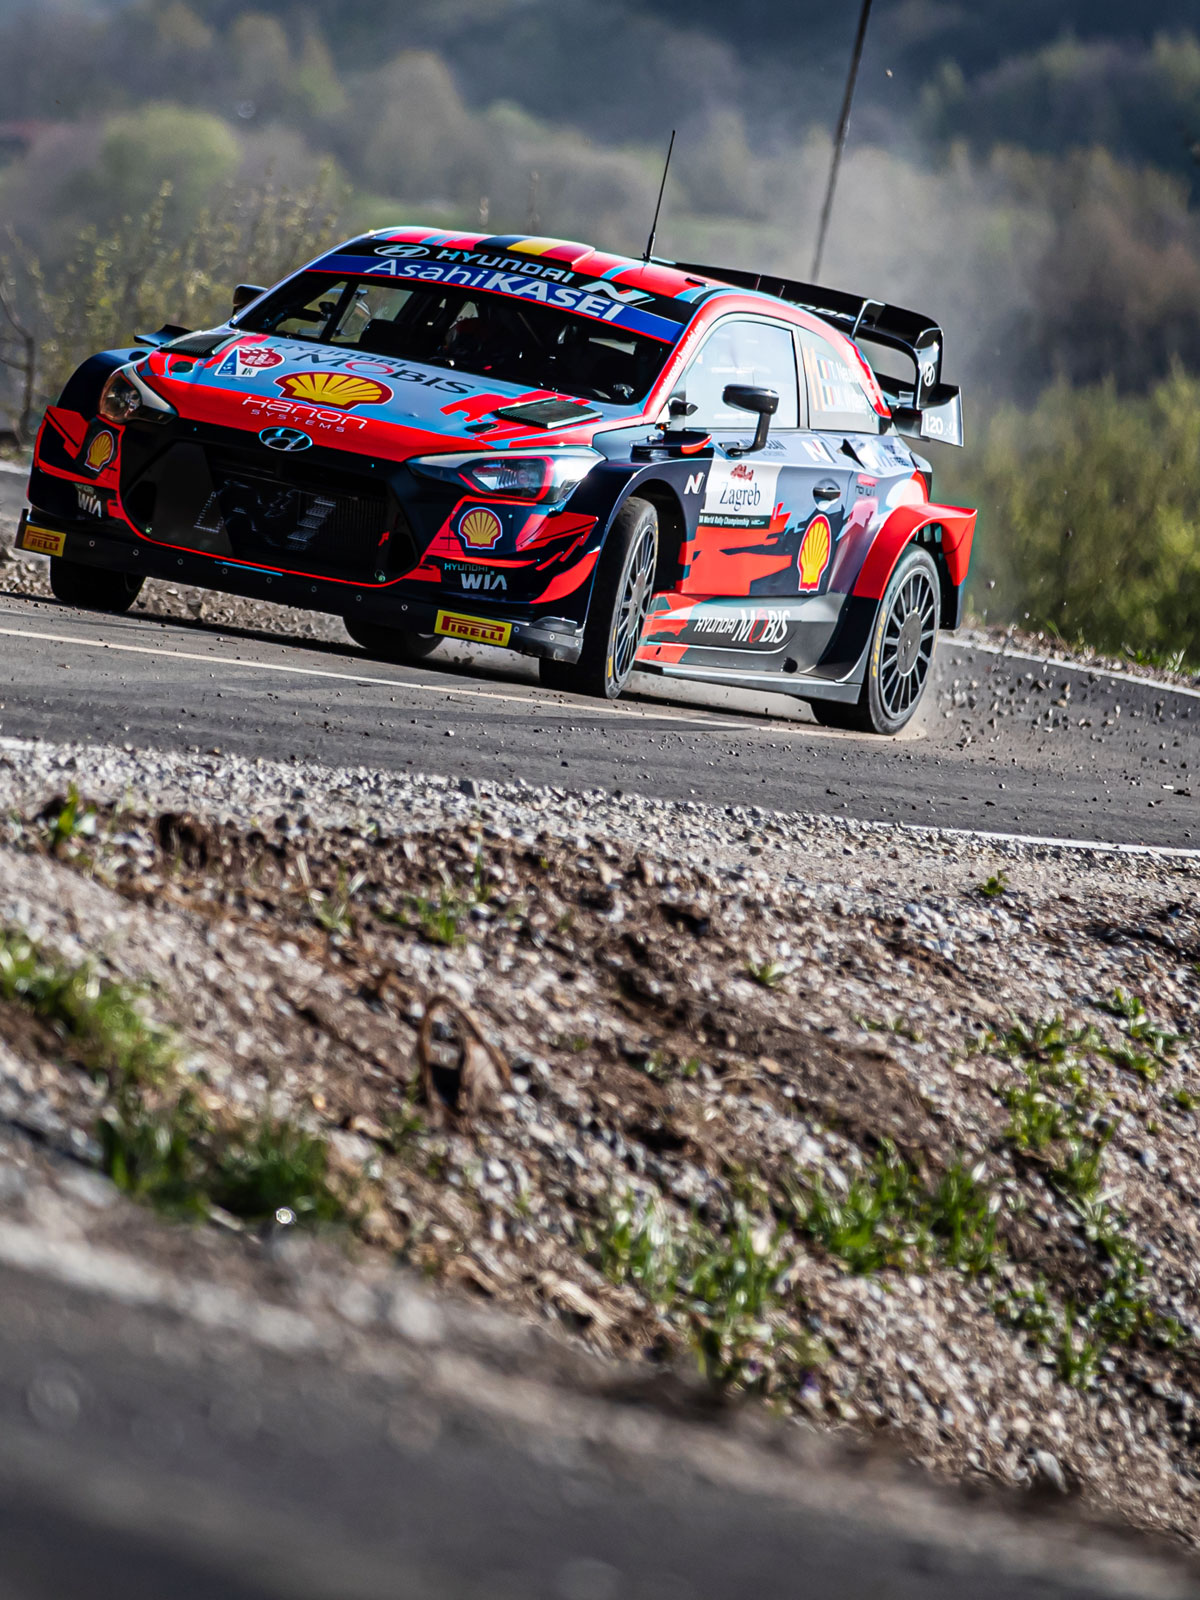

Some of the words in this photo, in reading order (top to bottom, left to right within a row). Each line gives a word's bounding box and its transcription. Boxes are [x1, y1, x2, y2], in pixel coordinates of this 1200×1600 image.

[436, 249, 574, 283] HYUNDAI
[272, 343, 407, 368] HYUNDAI
[295, 352, 476, 394] MOBIS
[250, 408, 346, 433] SYSTEMS
[78, 490, 102, 518] WIA
[719, 482, 761, 511] Zagreb
[444, 562, 489, 572] HYUNDAI
[461, 570, 508, 590] WIA
[441, 615, 505, 642] PIRELLI
[694, 616, 739, 633] HYUNDAI
[731, 608, 791, 643] MOBIS
